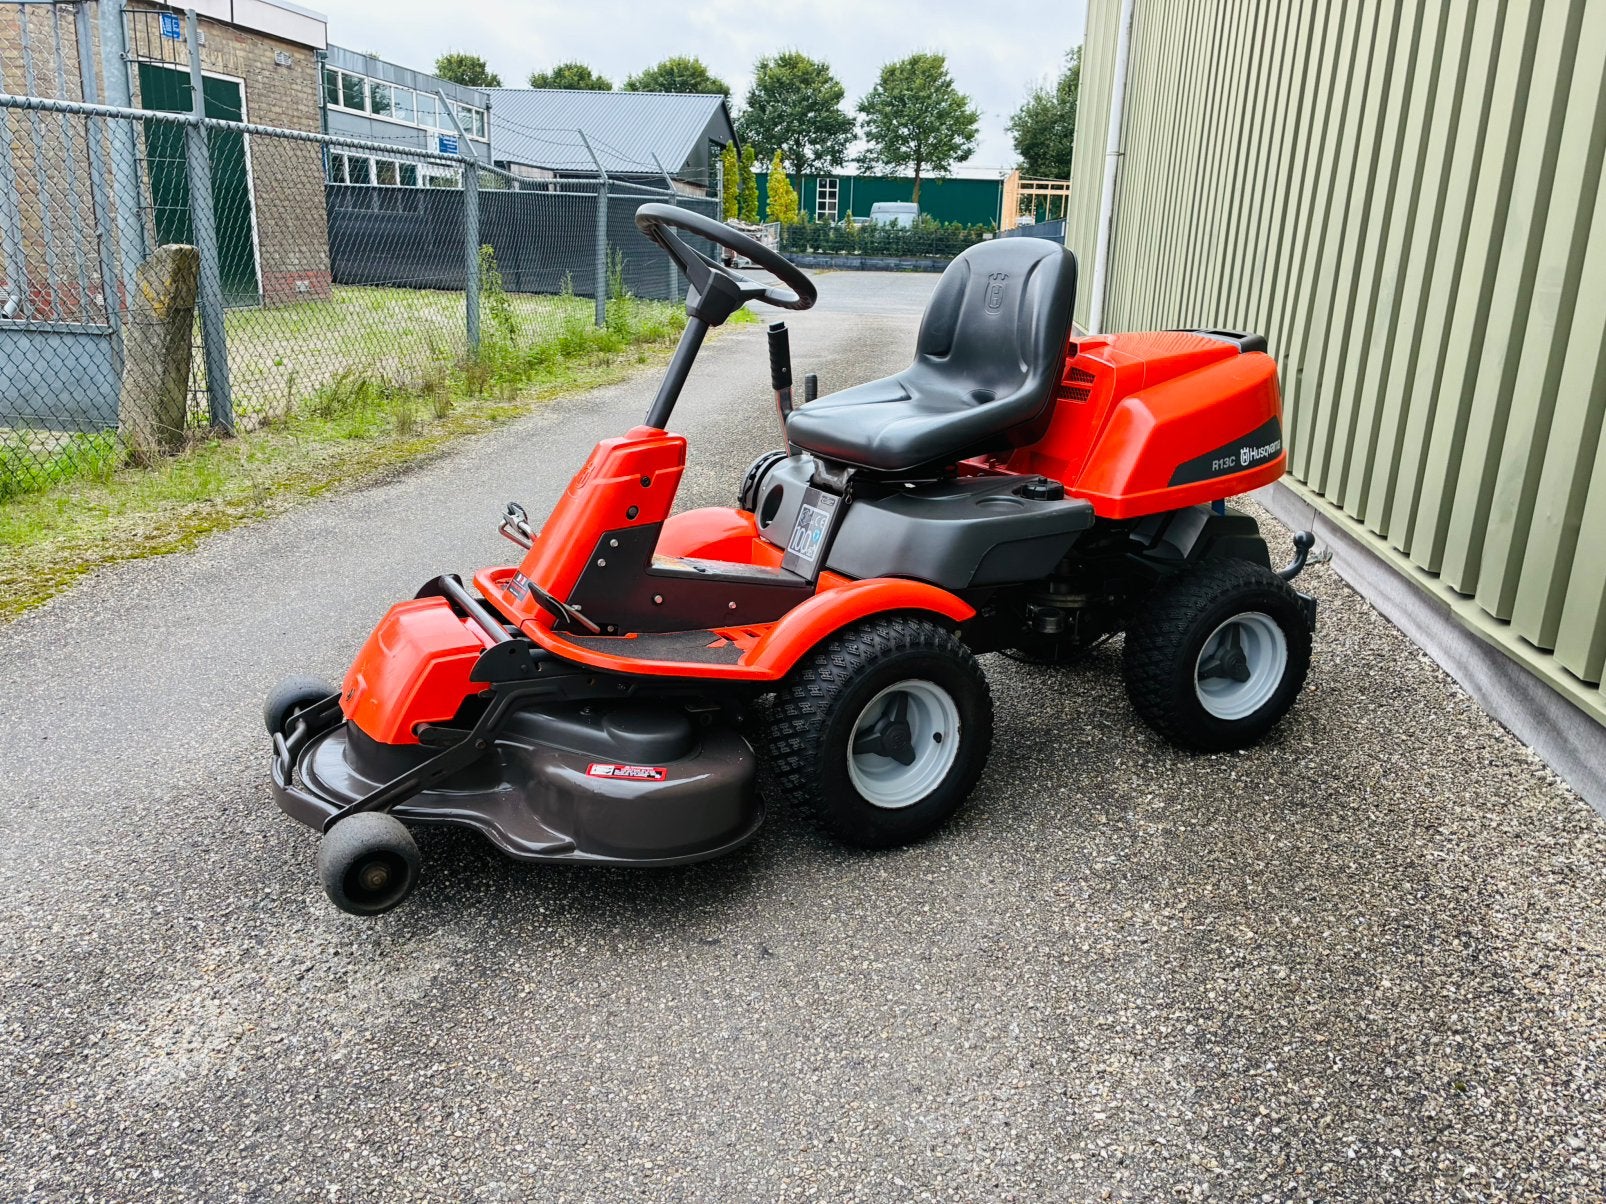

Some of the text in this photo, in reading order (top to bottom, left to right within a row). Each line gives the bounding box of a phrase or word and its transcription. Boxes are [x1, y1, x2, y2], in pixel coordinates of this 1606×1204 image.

[1212, 456, 1236, 471] R13C
[1249, 439, 1281, 461] Husqvarna
[790, 525, 812, 553] 100
